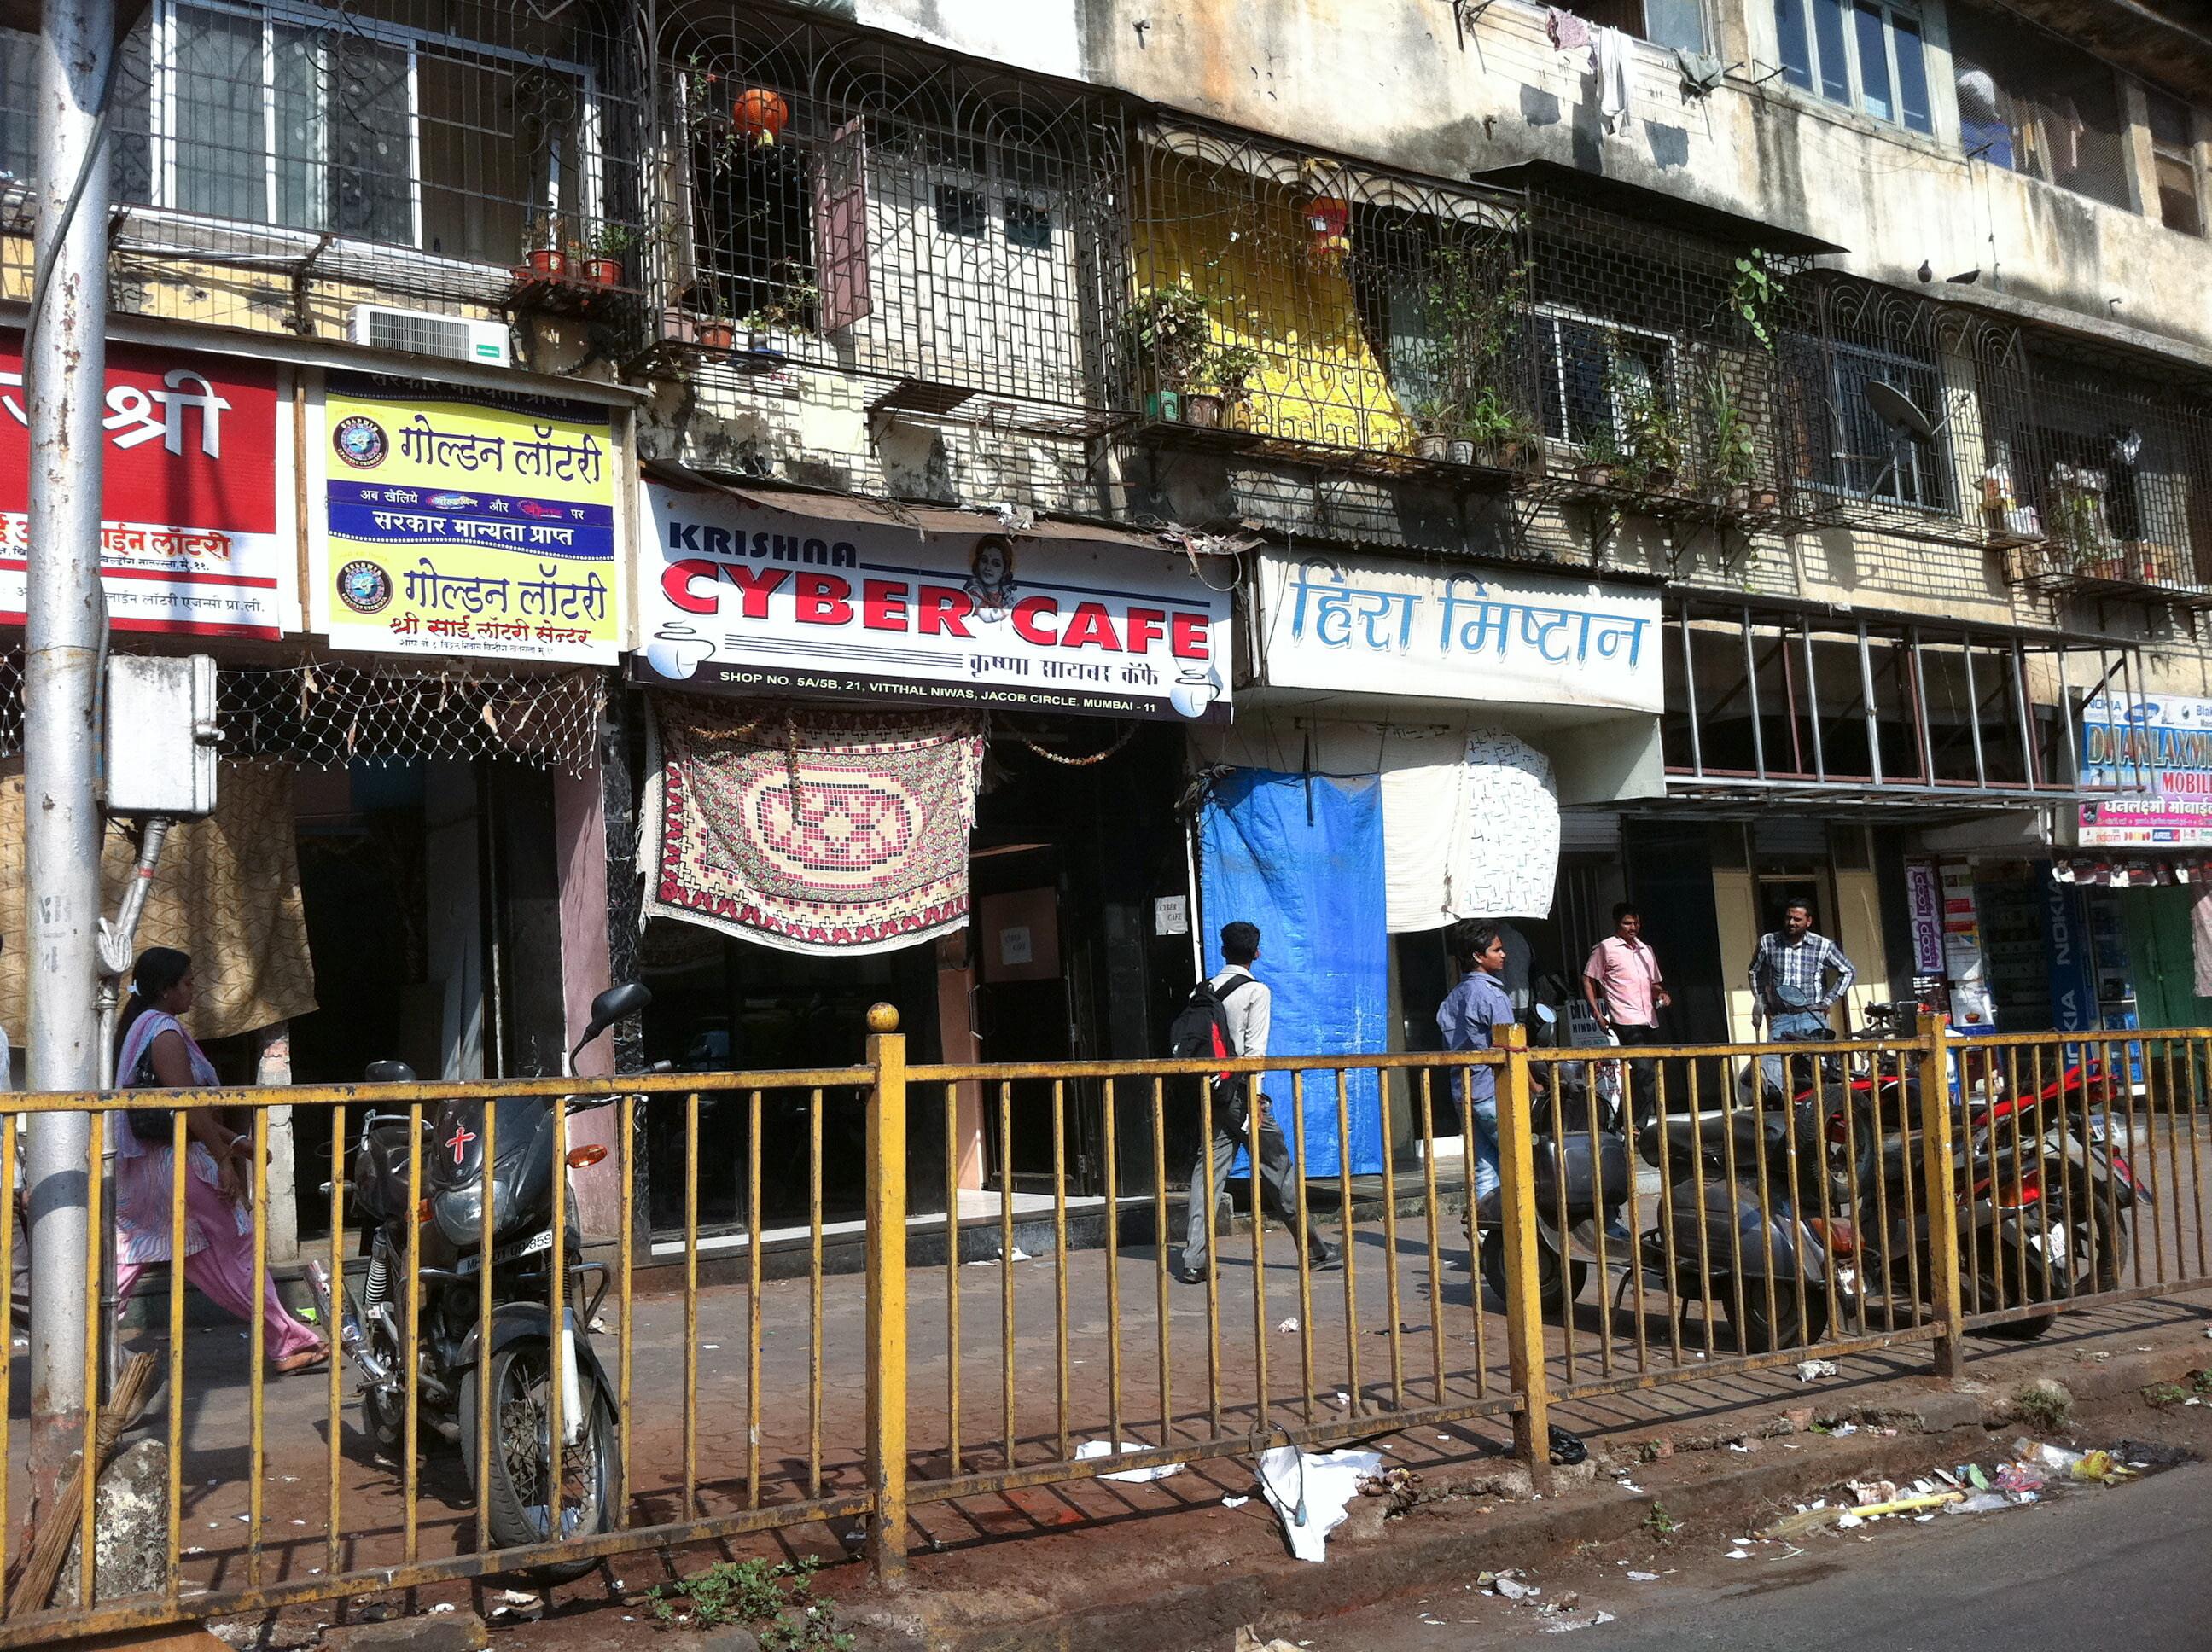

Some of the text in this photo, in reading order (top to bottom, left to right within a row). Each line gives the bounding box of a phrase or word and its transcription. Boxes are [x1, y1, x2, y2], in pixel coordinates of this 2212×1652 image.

[399, 415, 602, 484] गोल्डन लॉटरी
[360, 490, 380, 502] अब
[384, 489, 419, 505] खेलिये
[489, 498, 509, 513] और
[570, 509, 585, 520] पर
[150, 527, 234, 563] लॉटरी
[372, 510, 574, 546] सरकार मान्यता प्राप्त
[669, 521, 857, 568] KRISHNA
[403, 557, 607, 621] गोल्डन लॉटरी
[661, 558, 1210, 660] CYBER CAFE
[1289, 556, 1650, 676] हिरा मिष्टान
[389, 612, 420, 634] श्री
[476, 616, 530, 642] लॉटरी
[534, 620, 594, 648] सेन्टर
[969, 654, 1031, 678] कृष्णा
[719, 672, 762, 683] SHOP
[870, 683, 927, 696] VITTHAL
[930, 688, 978, 701] NIWAS,
[981, 690, 1027, 703] JACOB
[1083, 698, 1133, 712] MUMBAI
[2162, 771, 2212, 794] MOBIL
